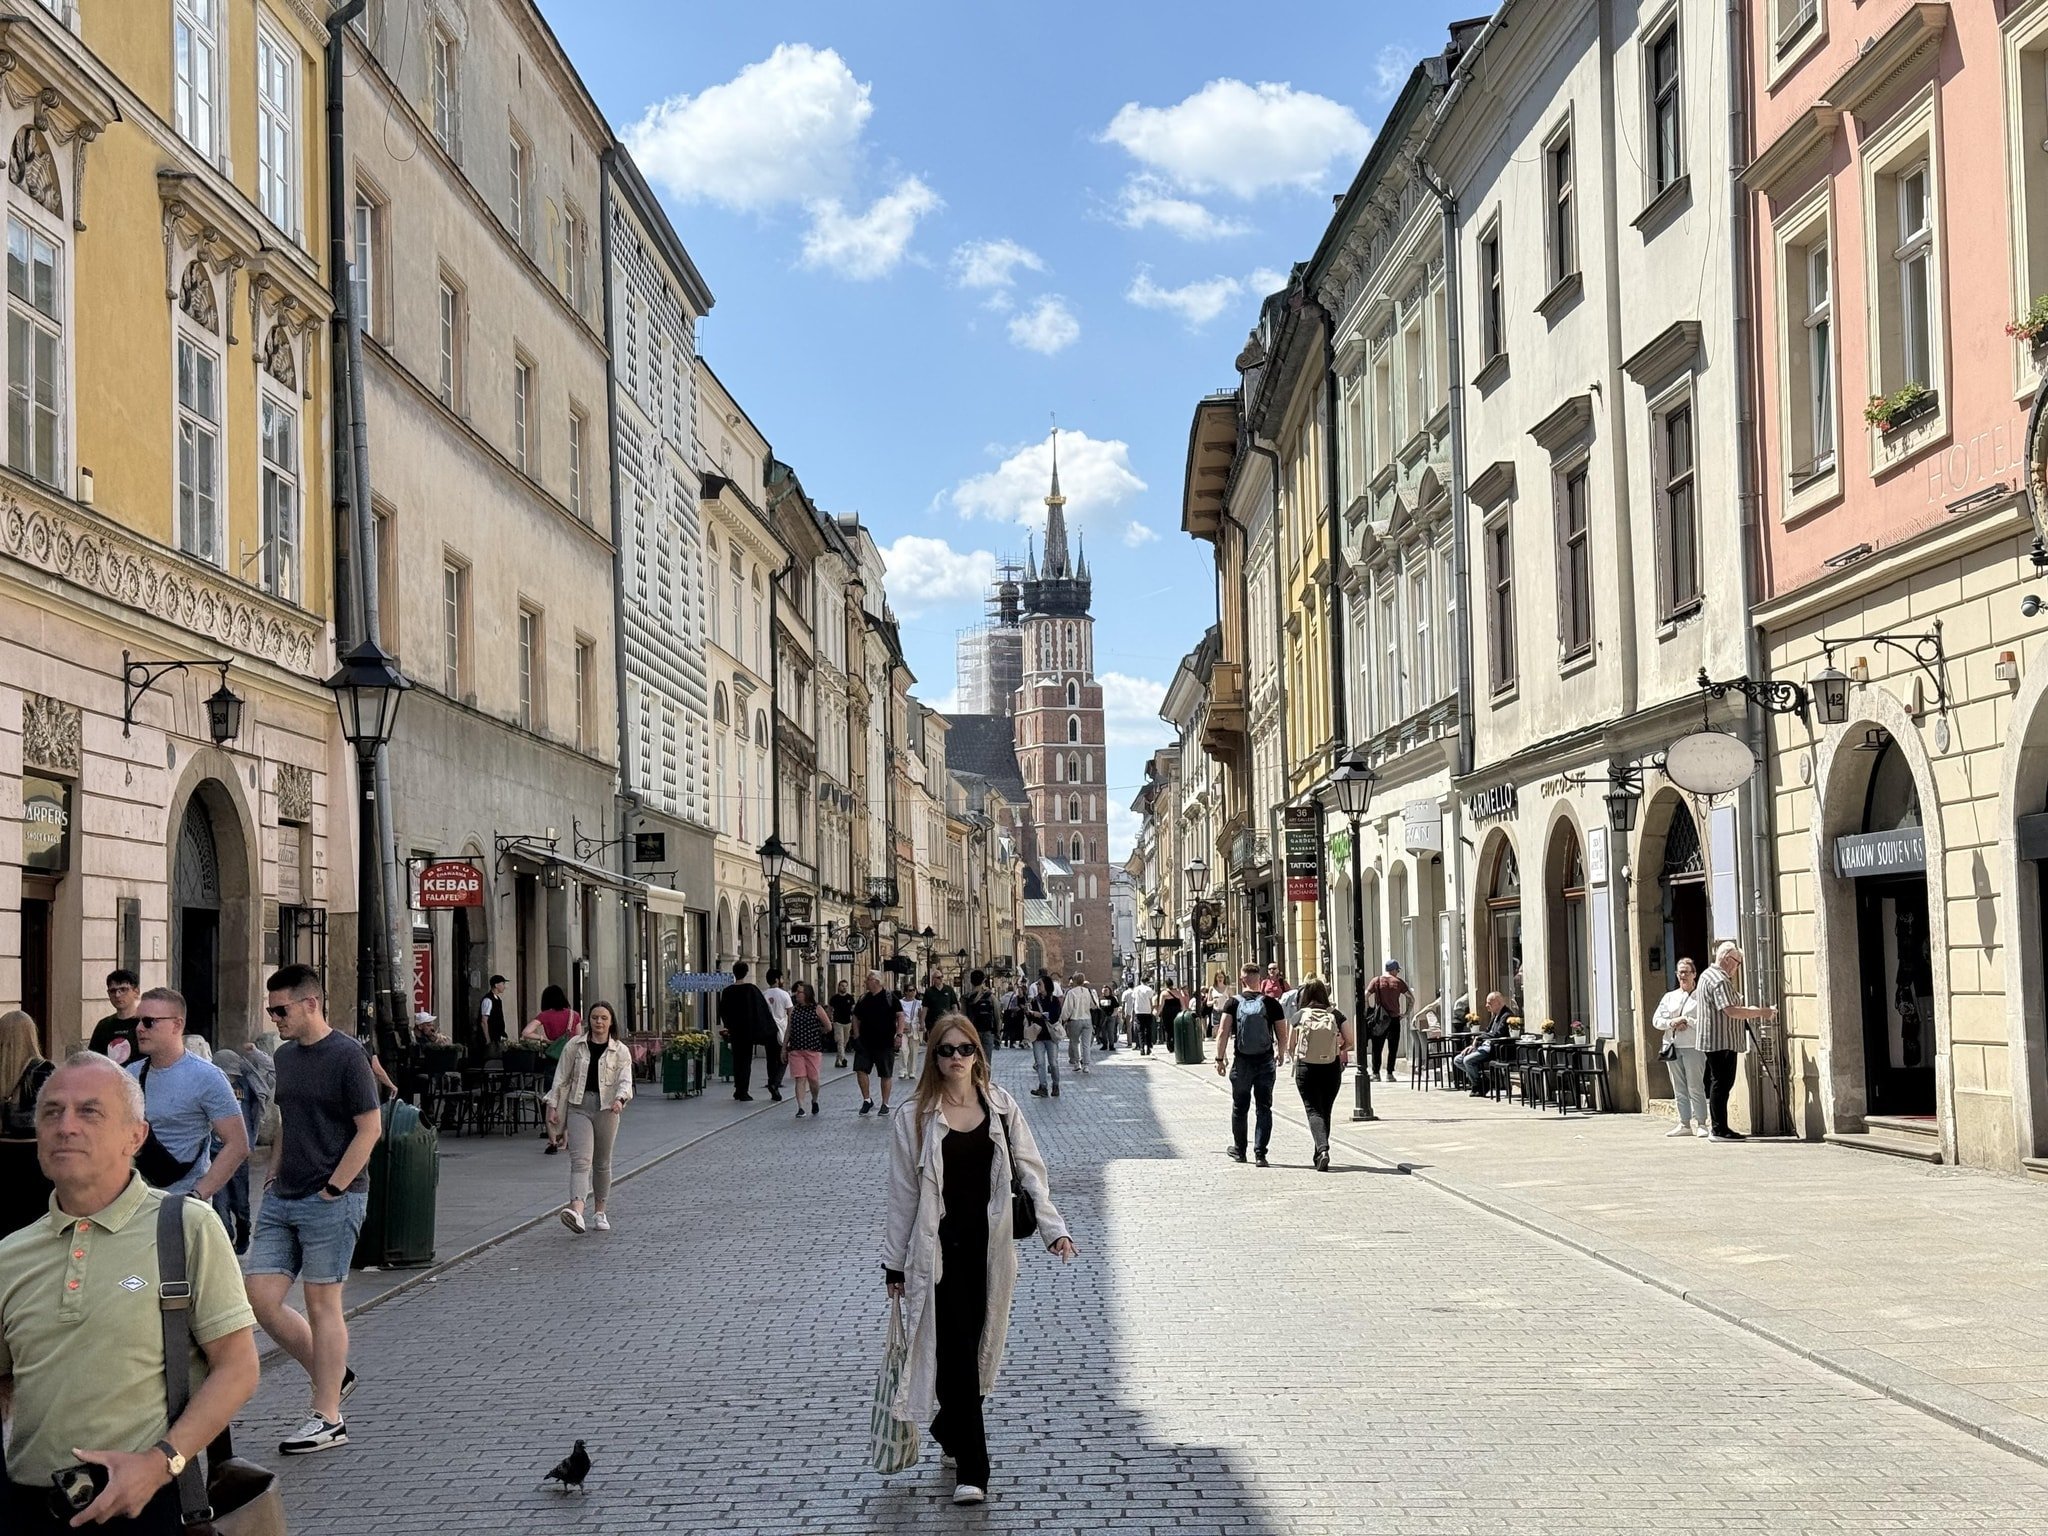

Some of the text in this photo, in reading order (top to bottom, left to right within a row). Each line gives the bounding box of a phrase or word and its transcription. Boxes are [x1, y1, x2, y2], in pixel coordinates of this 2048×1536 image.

[1927, 418, 2024, 504] HOTEL
[1829, 693, 1844, 706] 42
[213, 713, 226, 724] 53
[1467, 783, 1513, 820] KARMELLO
[1297, 809, 1307, 817] 36
[1841, 838, 1924, 870] KRAKÓW SOUVENIRS
[427, 865, 479, 878] BEIRUT
[423, 879, 480, 892] KEBAB
[425, 893, 460, 902] FALAFEL
[787, 934, 808, 943] PUB
[412, 953, 425, 1012] EXC
